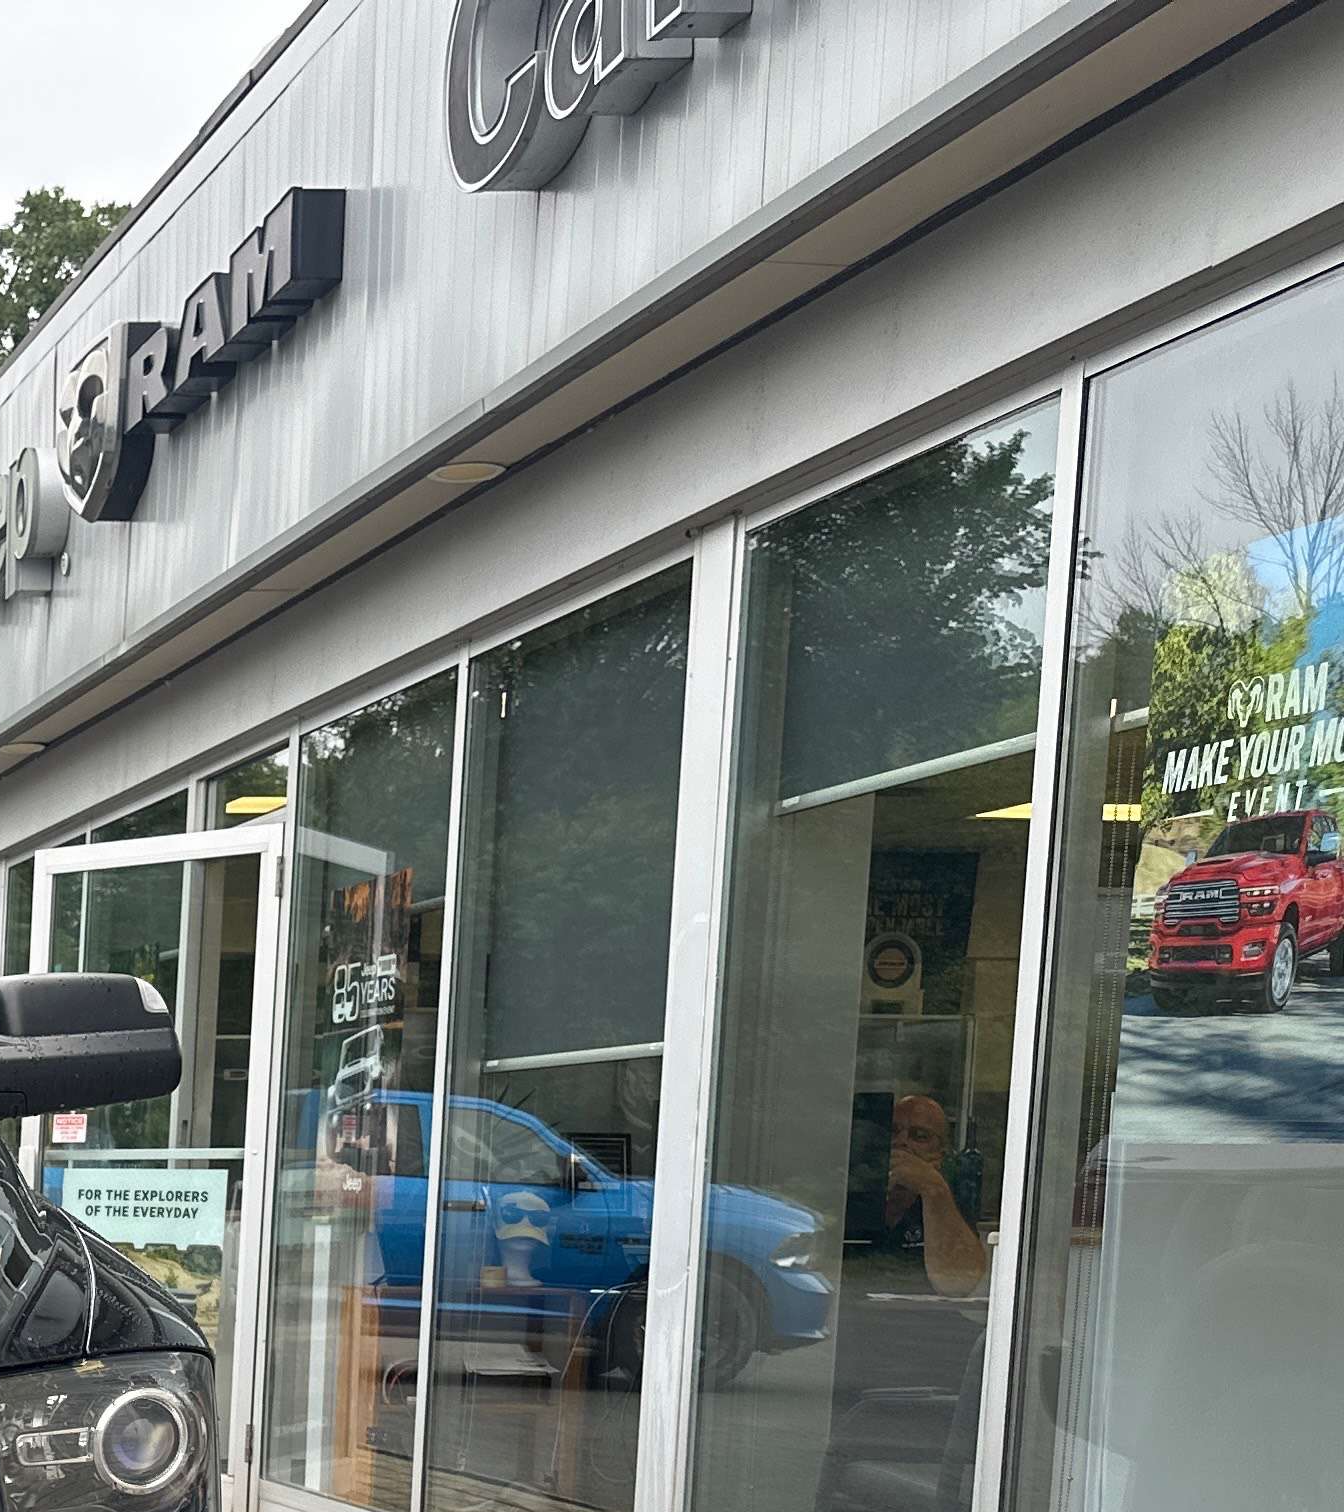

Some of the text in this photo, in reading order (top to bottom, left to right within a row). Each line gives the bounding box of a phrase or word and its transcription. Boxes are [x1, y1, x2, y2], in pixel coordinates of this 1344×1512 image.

[124, 187, 307, 435] RAM
[1264, 661, 1330, 723] RAM
[1161, 738, 1235, 795] MAKE
[1237, 724, 1307, 781] YOUR
[1226, 779, 1308, 823] EVENT
[1180, 888, 1219, 901] RAM
[332, 961, 362, 1024] 85
[360, 976, 397, 1004] YEARS
[77, 1188, 209, 1203] FOR THE EXPLORERS
[342, 1173, 363, 1193] Jeep
[85, 1205, 200, 1219] OF THE EVERYDAY
